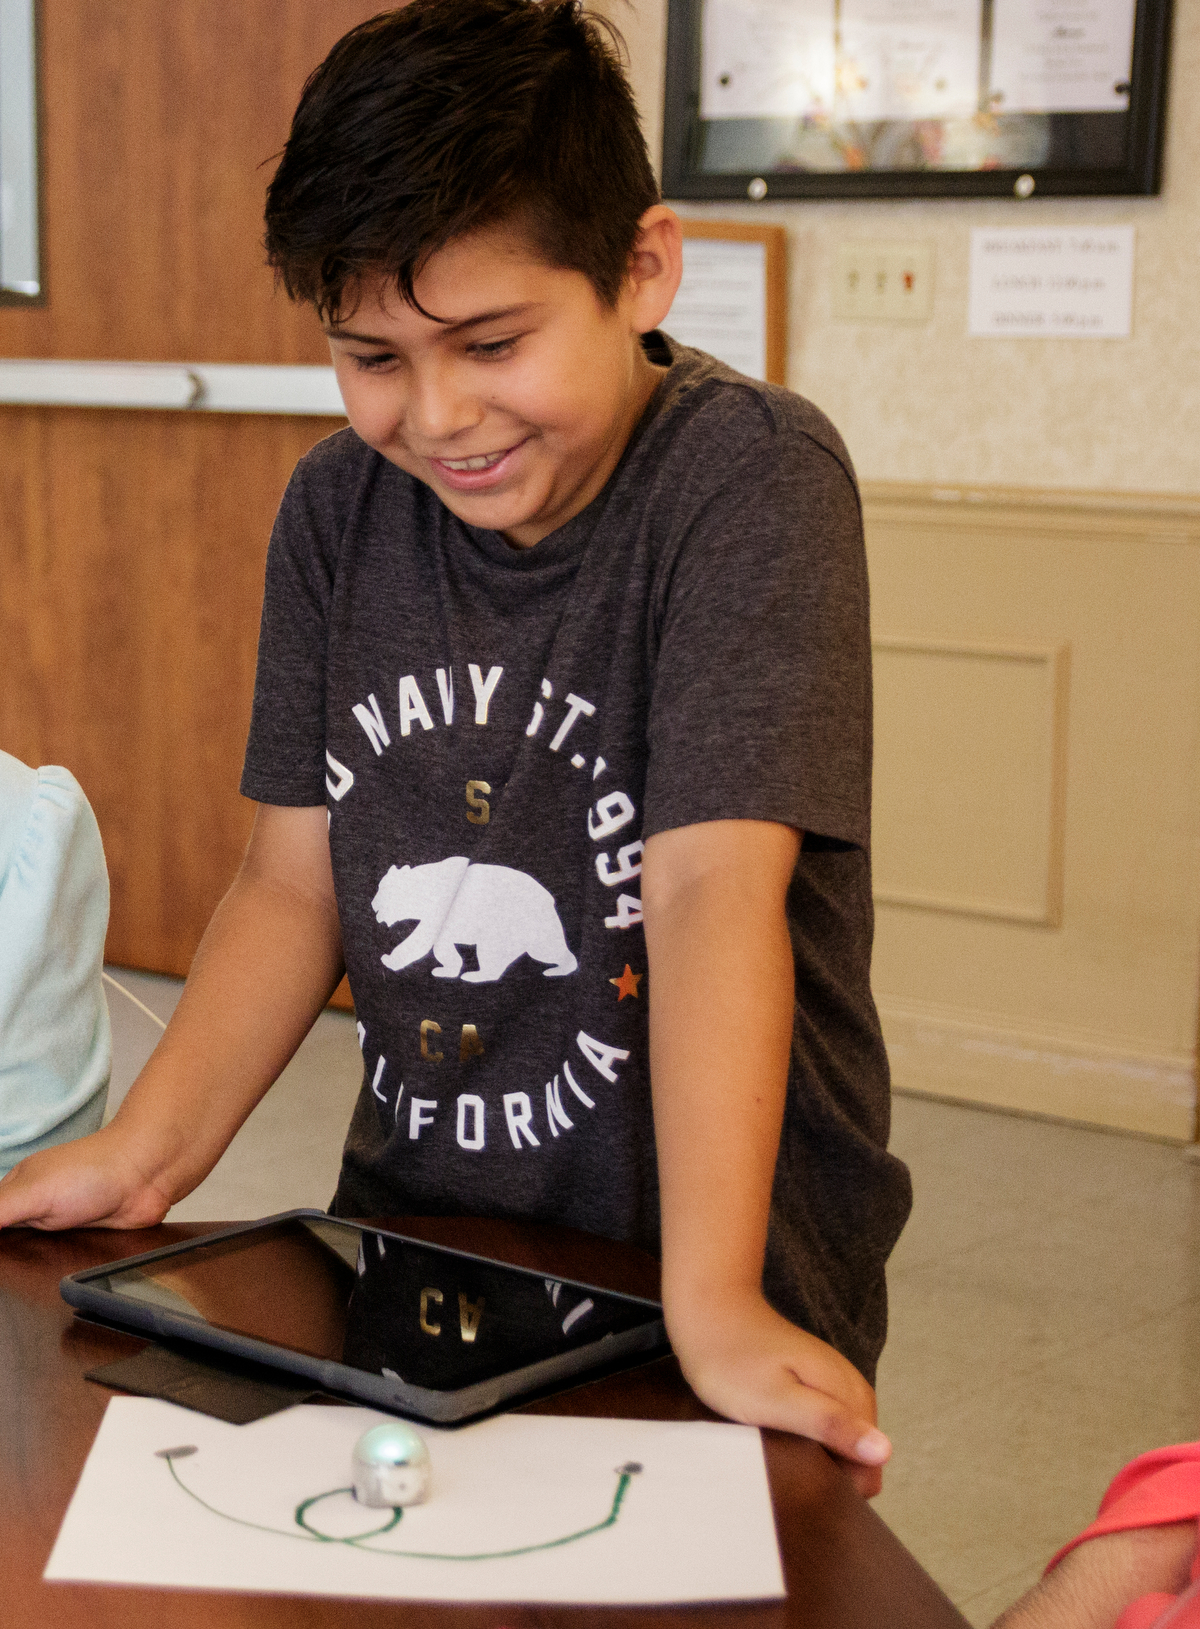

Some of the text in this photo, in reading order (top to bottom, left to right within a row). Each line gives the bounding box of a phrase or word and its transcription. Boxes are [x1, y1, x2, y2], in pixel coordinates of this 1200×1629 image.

[351, 663, 504, 757] NAVY
[588, 754, 645, 928] 994
[466, 779, 492, 825] S
[357, 1021, 631, 1151] LIFORNIA
